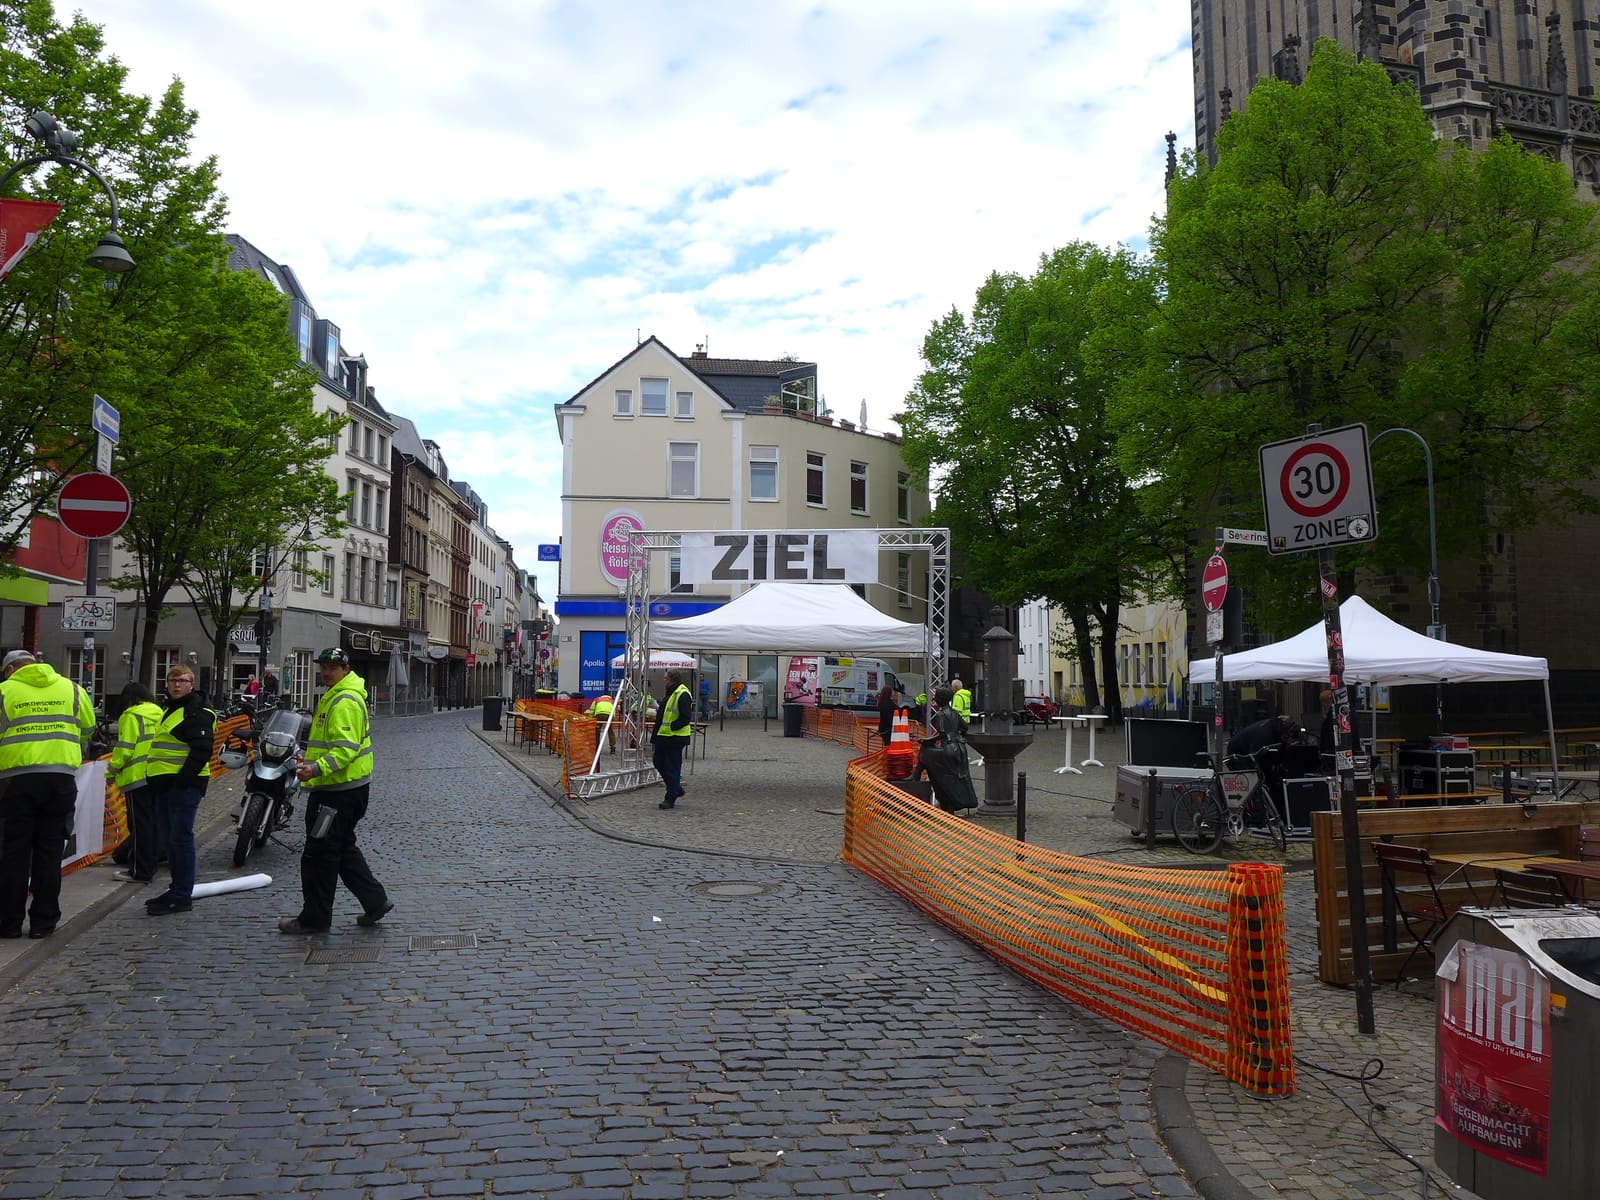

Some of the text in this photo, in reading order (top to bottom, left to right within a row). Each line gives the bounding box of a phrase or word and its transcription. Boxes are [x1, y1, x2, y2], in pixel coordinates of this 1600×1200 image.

[1294, 461, 1335, 499] 30
[1293, 517, 1347, 543] ZONE
[711, 534, 846, 581] ZIEL
[81, 618, 97, 627] frei
[583, 659, 605, 669] Apollo
[1484, 1039, 1492, 1048] 17
[1510, 1048, 1526, 1060] Kalk
[1526, 1052, 1542, 1064] Post
[1453, 1102, 1531, 1137] GEGENMACHT
[1458, 1118, 1522, 1149] AUFBAUEN!
